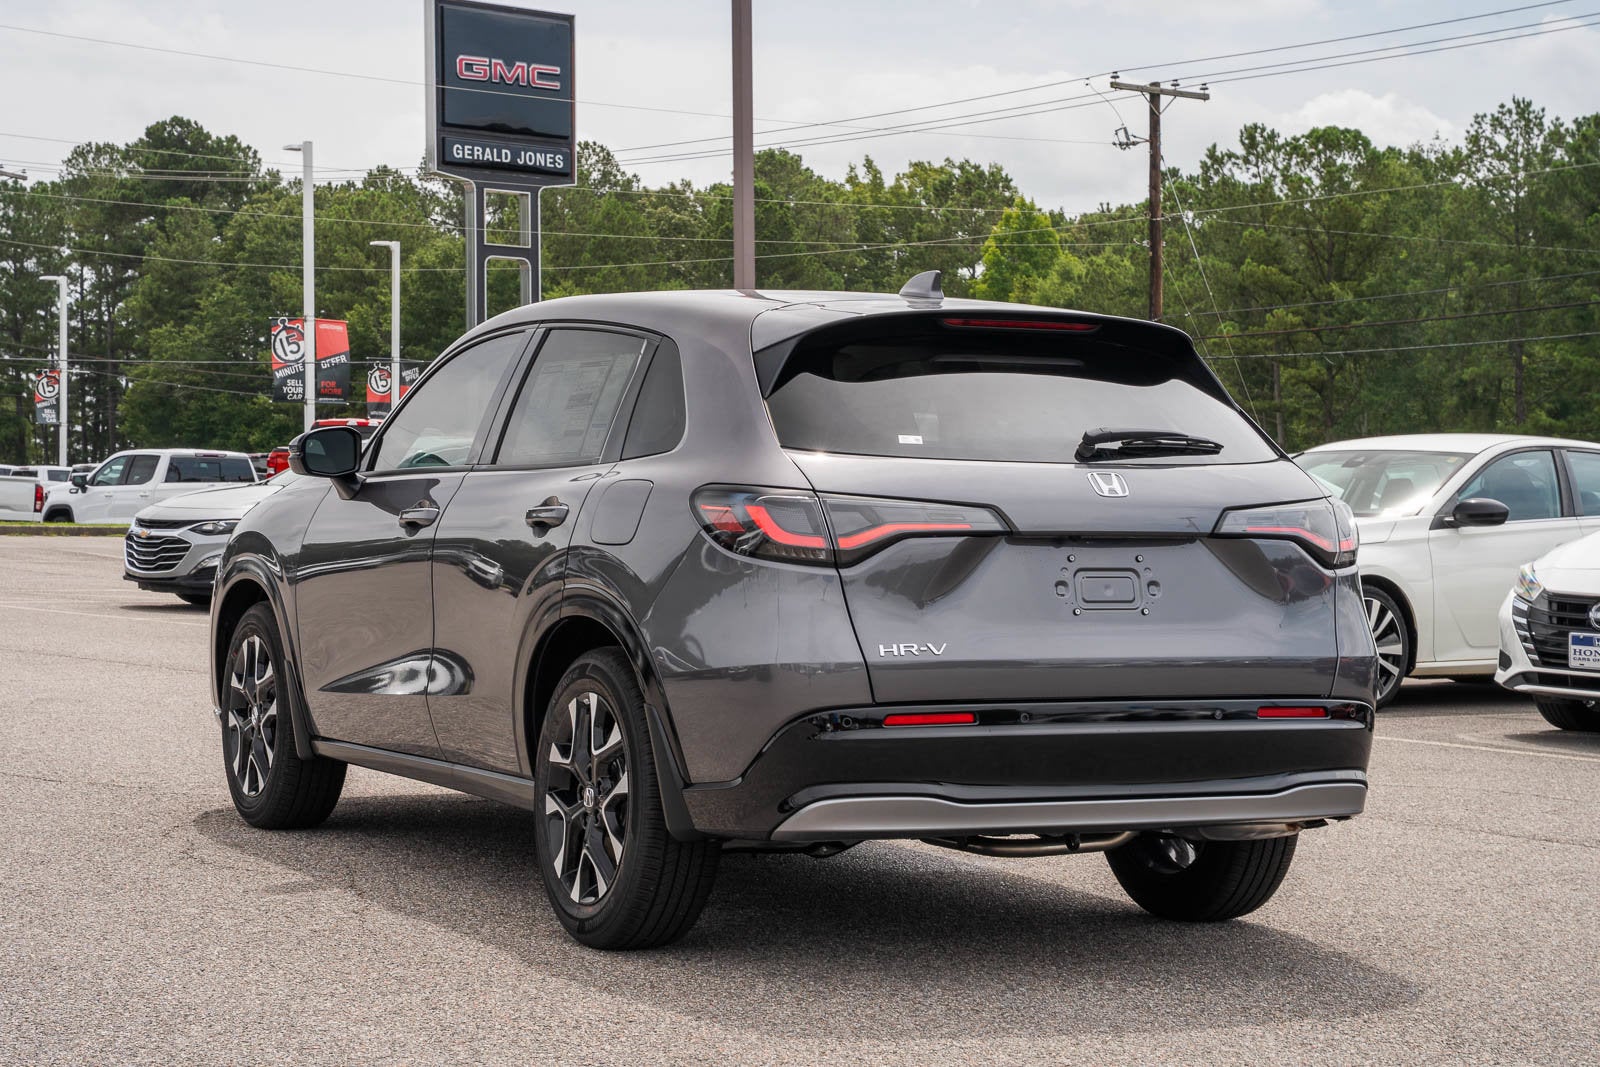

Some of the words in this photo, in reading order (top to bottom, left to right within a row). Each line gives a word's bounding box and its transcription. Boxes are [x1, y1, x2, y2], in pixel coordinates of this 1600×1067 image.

[456, 54, 561, 90] GMC
[452, 143, 511, 163] GERALD
[517, 151, 564, 169] JONES
[279, 333, 301, 357] 15
[321, 354, 347, 369] OFFER
[275, 363, 304, 379] MINUTE
[41, 380, 55, 394] 15
[286, 379, 304, 387] SELL
[320, 380, 337, 388] FOR
[374, 373, 388, 390] 15
[282, 386, 304, 394] YOUR
[320, 387, 342, 395] MORE
[878, 642, 947, 657] HR-V
